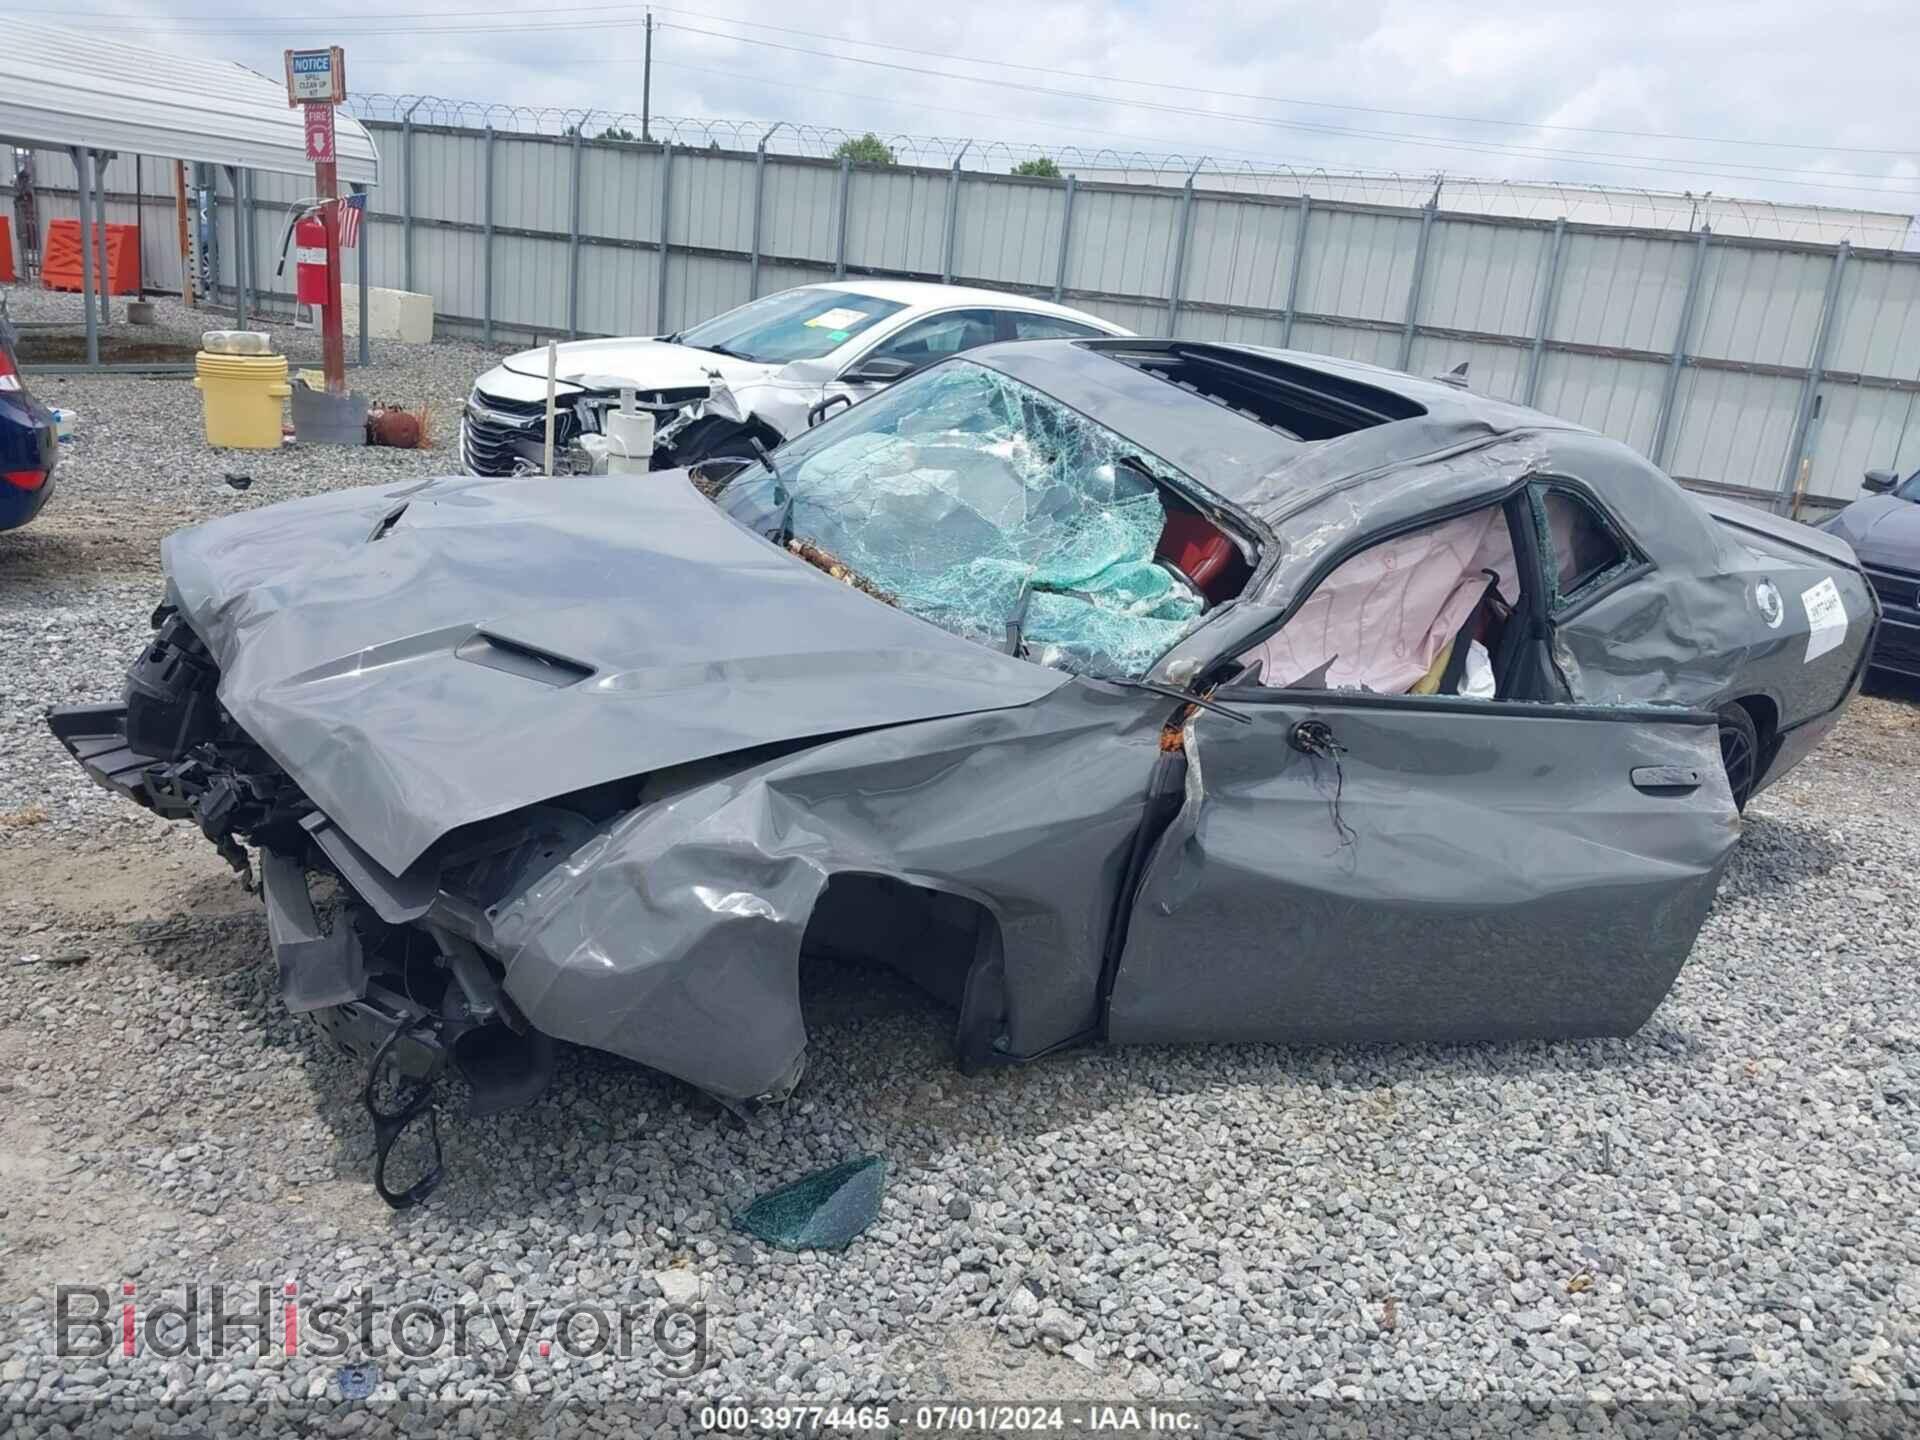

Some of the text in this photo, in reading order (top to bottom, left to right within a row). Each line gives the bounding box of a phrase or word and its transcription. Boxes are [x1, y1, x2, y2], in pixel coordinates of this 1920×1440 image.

[295, 57, 329, 71] NOTICE
[299, 81, 317, 89] CLEAN
[309, 111, 327, 121] FIRE
